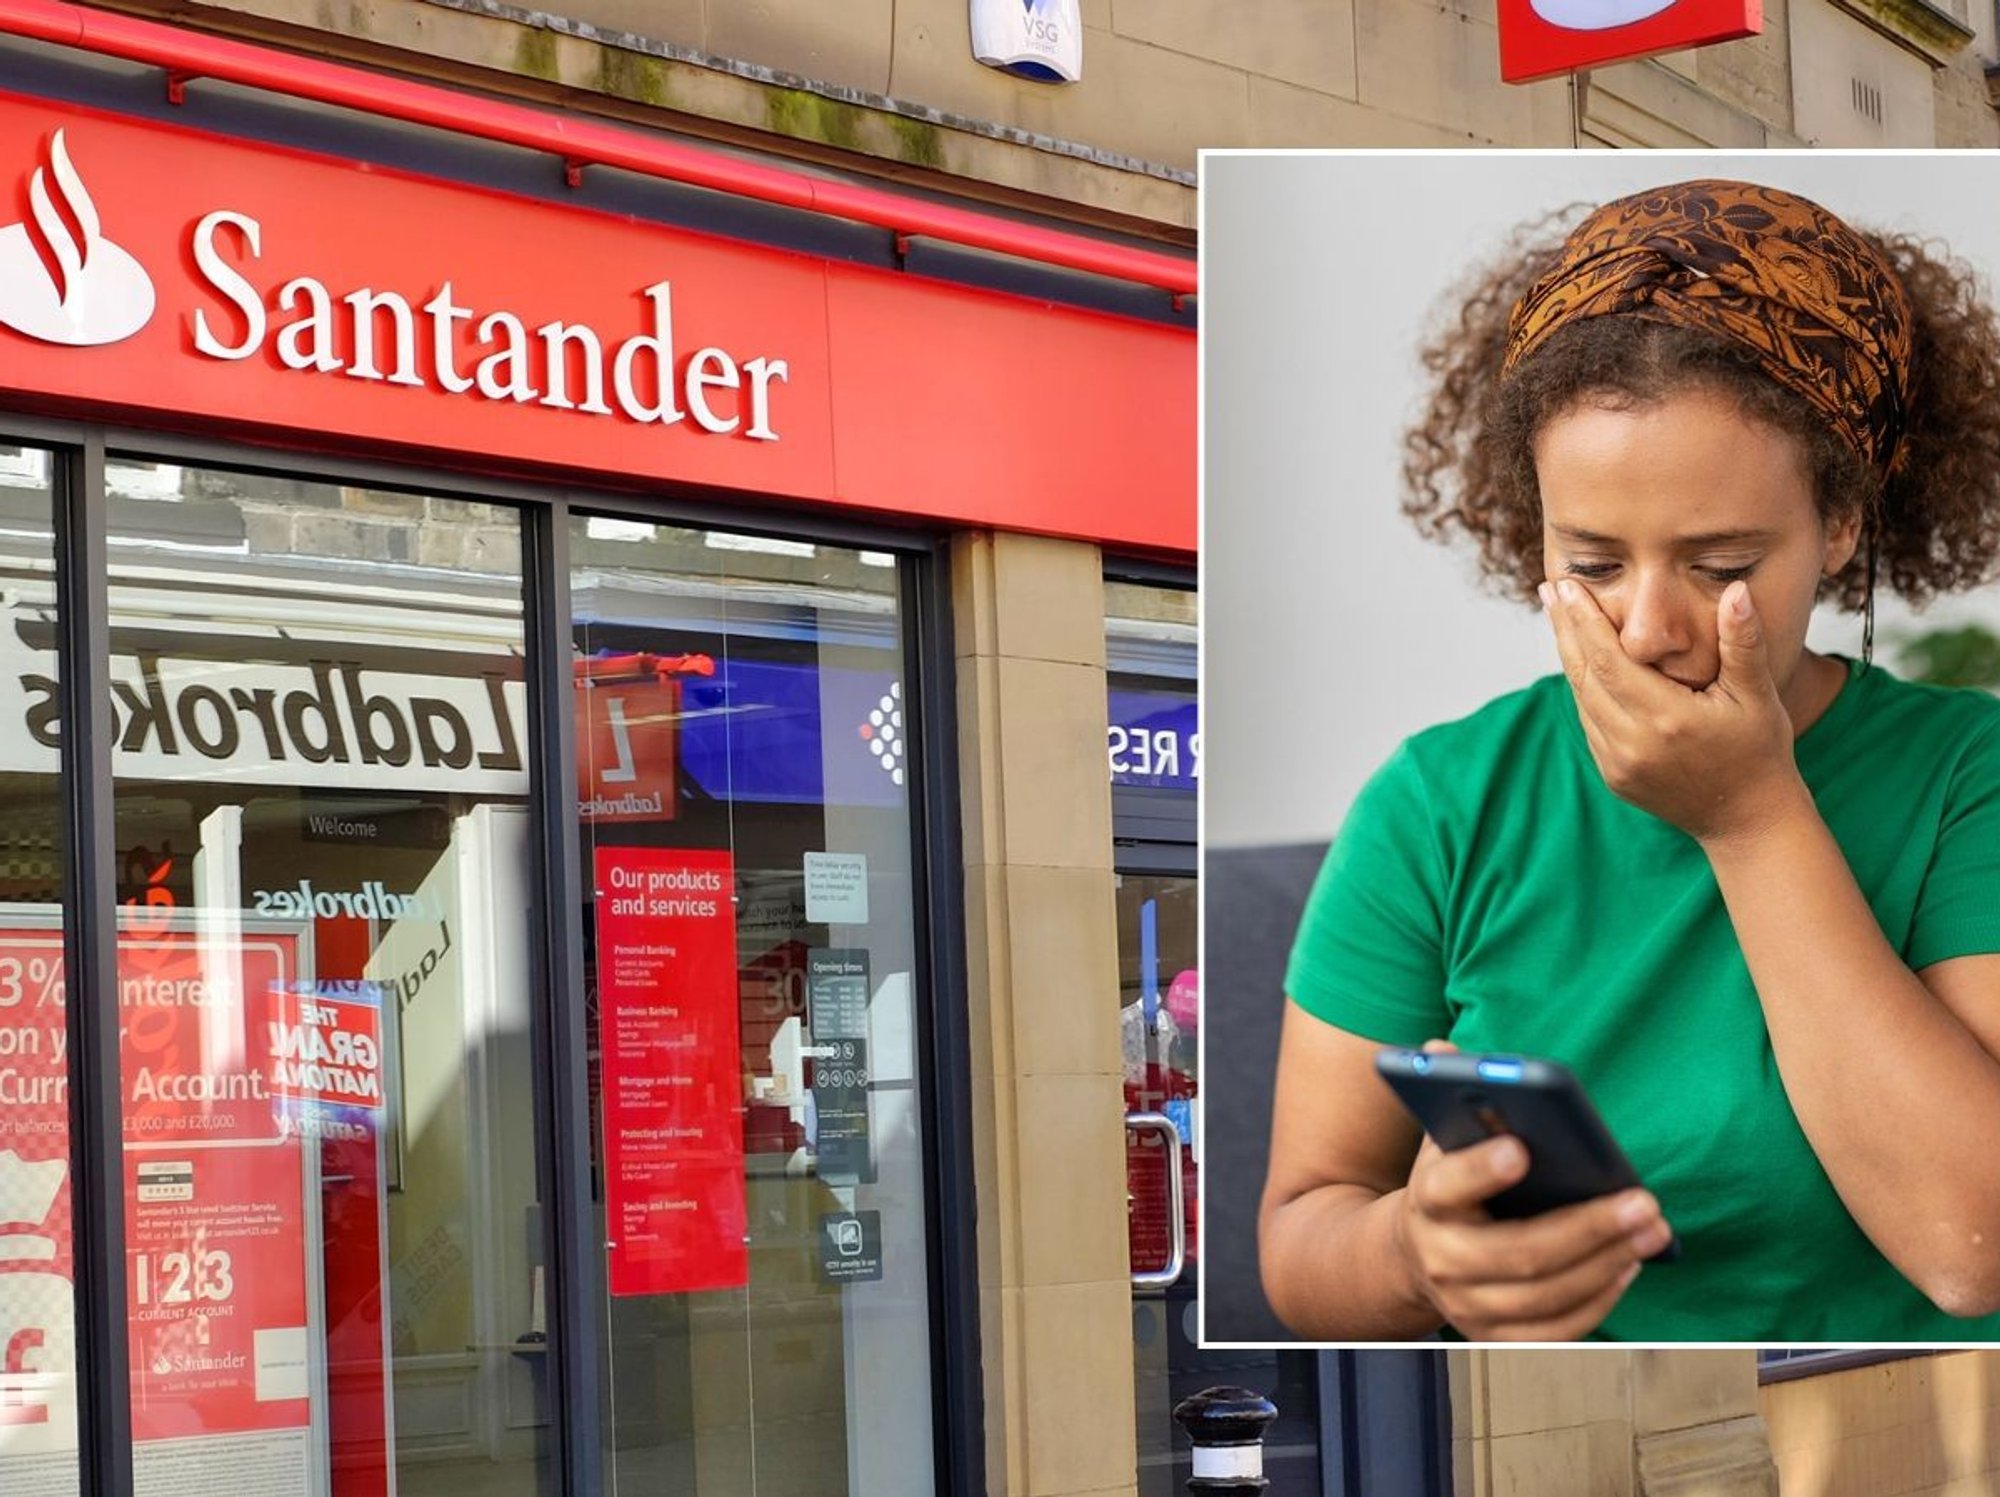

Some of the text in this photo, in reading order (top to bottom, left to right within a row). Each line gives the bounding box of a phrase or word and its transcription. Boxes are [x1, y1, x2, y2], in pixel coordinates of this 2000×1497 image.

[1022, 16, 1059, 43] VSG
[192, 209, 788, 442] Santander
[310, 817, 377, 838] Welcome
[610, 866, 721, 894] Our products
[611, 893, 644, 915] and
[649, 895, 717, 917] services
[813, 962, 843, 974] Opening
[0, 957, 66, 1009] 3%
[0, 1027, 39, 1055] on
[132, 1067, 271, 1102] Account.
[165, 1115, 187, 1131] and
[138, 1304, 234, 1321] CURRENT ACCOUNT
[174, 1352, 246, 1373] Santander
